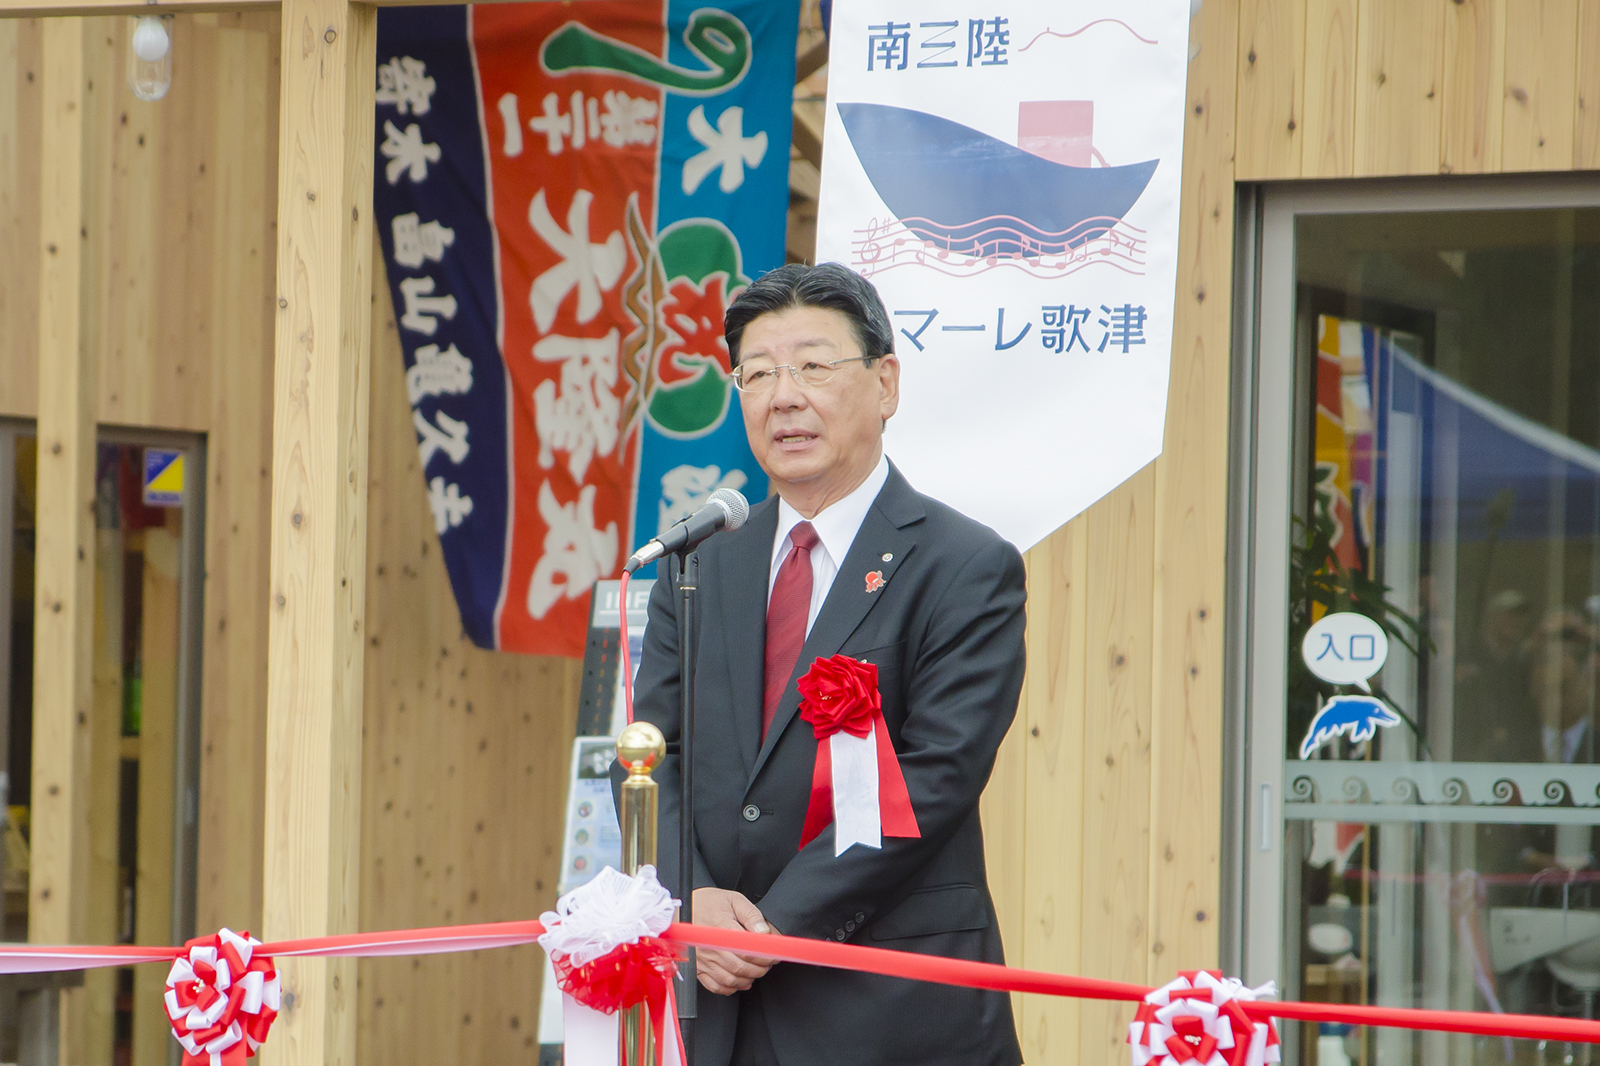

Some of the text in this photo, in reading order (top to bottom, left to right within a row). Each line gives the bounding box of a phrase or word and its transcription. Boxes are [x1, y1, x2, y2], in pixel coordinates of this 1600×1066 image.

[867, 16, 1010, 72] 南三陸
[894, 304, 1148, 354] マーレ歌津
[527, 187, 627, 620] 大隆丸
[1316, 633, 1375, 661] 入口
